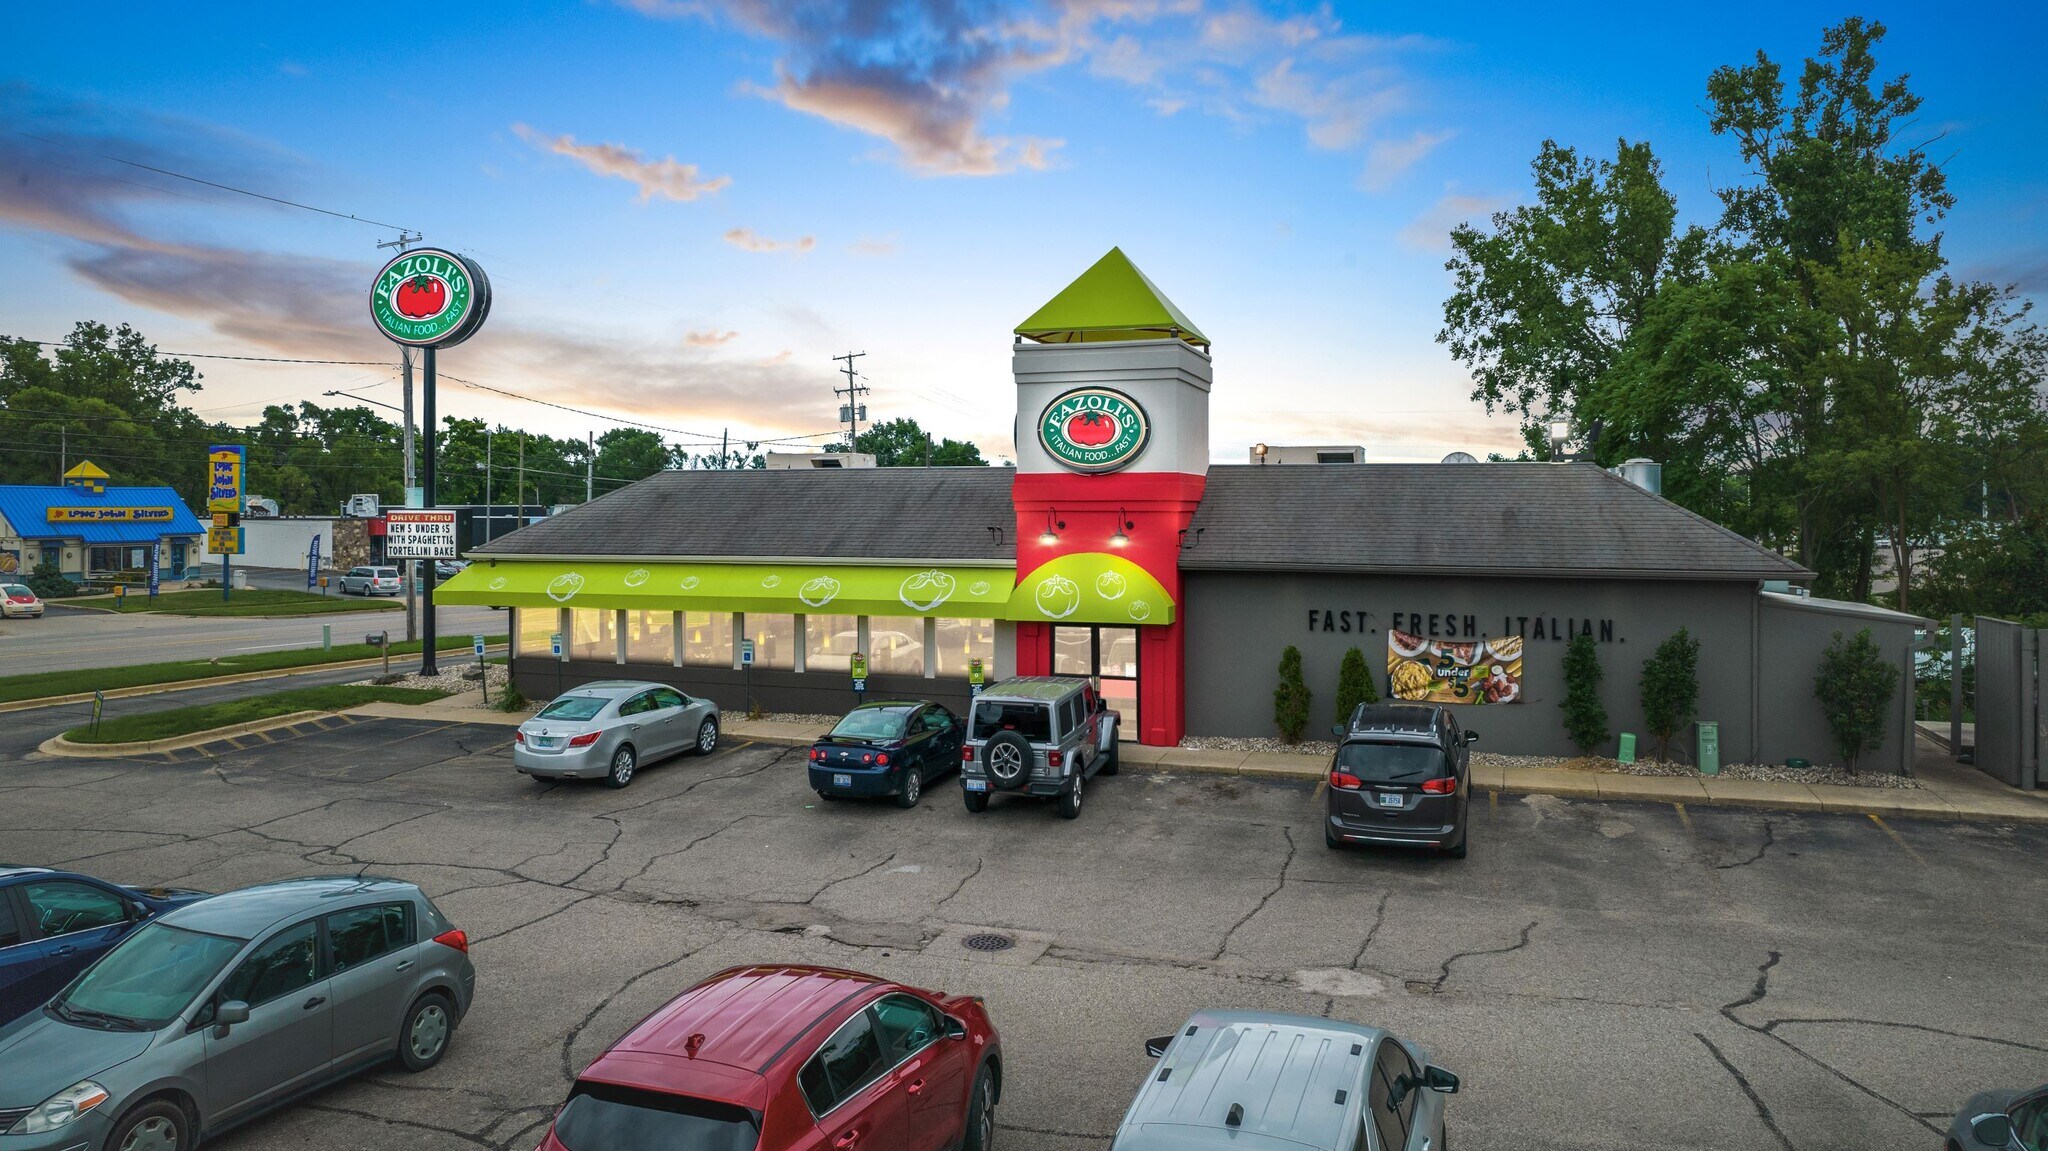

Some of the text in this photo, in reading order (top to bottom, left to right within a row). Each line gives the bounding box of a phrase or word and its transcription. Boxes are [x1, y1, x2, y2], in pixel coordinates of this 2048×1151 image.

[377, 257, 465, 300] FAZOLI'S
[380, 307, 411, 334] ITALIAN
[1049, 396, 1135, 429] FAZOLI'S
[1051, 435, 1082, 460] ITALIAN
[388, 535, 406, 544] WITH
[390, 524, 405, 533] NEW
[415, 524, 440, 534] UNDER
[442, 524, 450, 533] $5
[389, 546, 454, 556] TORTELLINI BAKE
[1308, 609, 1625, 643] FAST. FRESH. ITALIAN.
[1437, 648, 1456, 670] 5
[1448, 675, 1469, 698] $5
